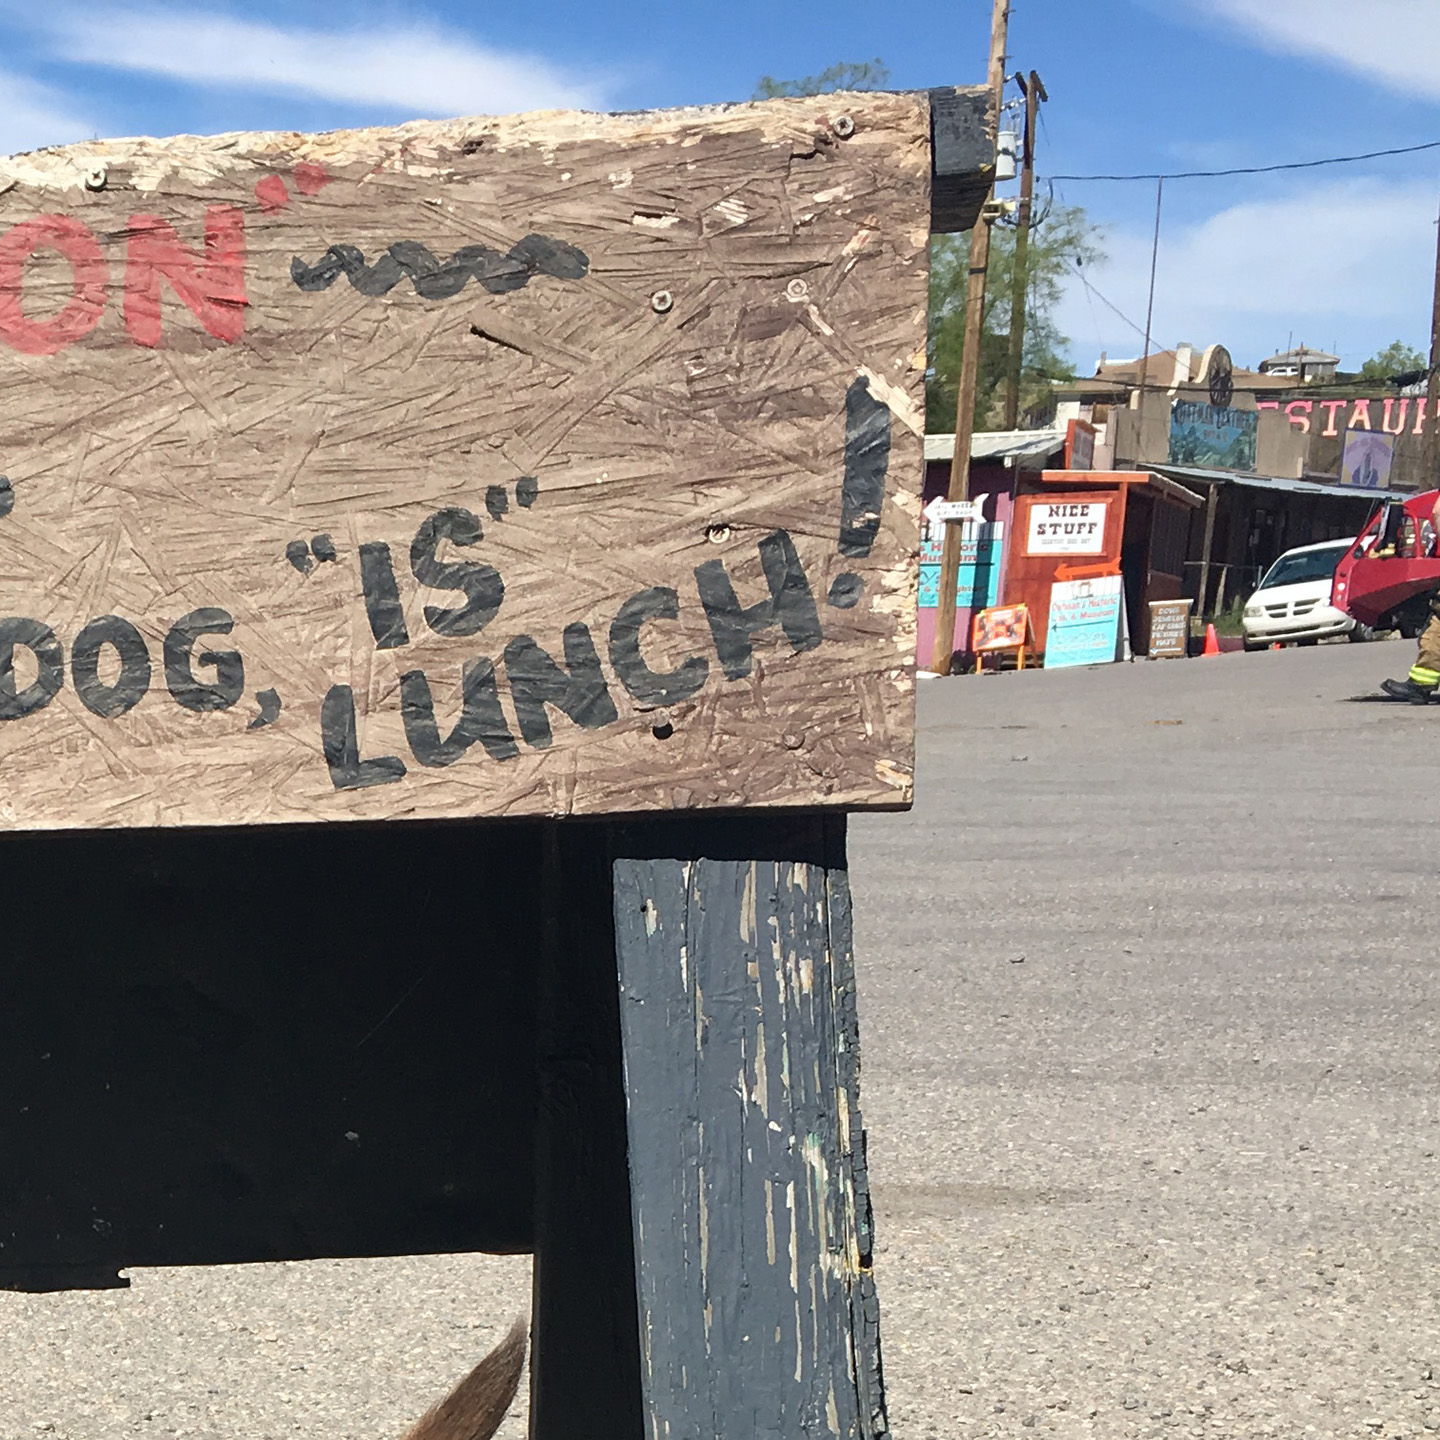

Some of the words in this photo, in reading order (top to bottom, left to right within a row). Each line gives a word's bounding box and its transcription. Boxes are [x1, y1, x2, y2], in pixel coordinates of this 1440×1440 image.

[1037, 522, 1098, 536] STUFF
[1048, 505, 1090, 518] NICE
[286, 475, 539, 650] "IS"
[321, 375, 892, 790] LUNCH!
